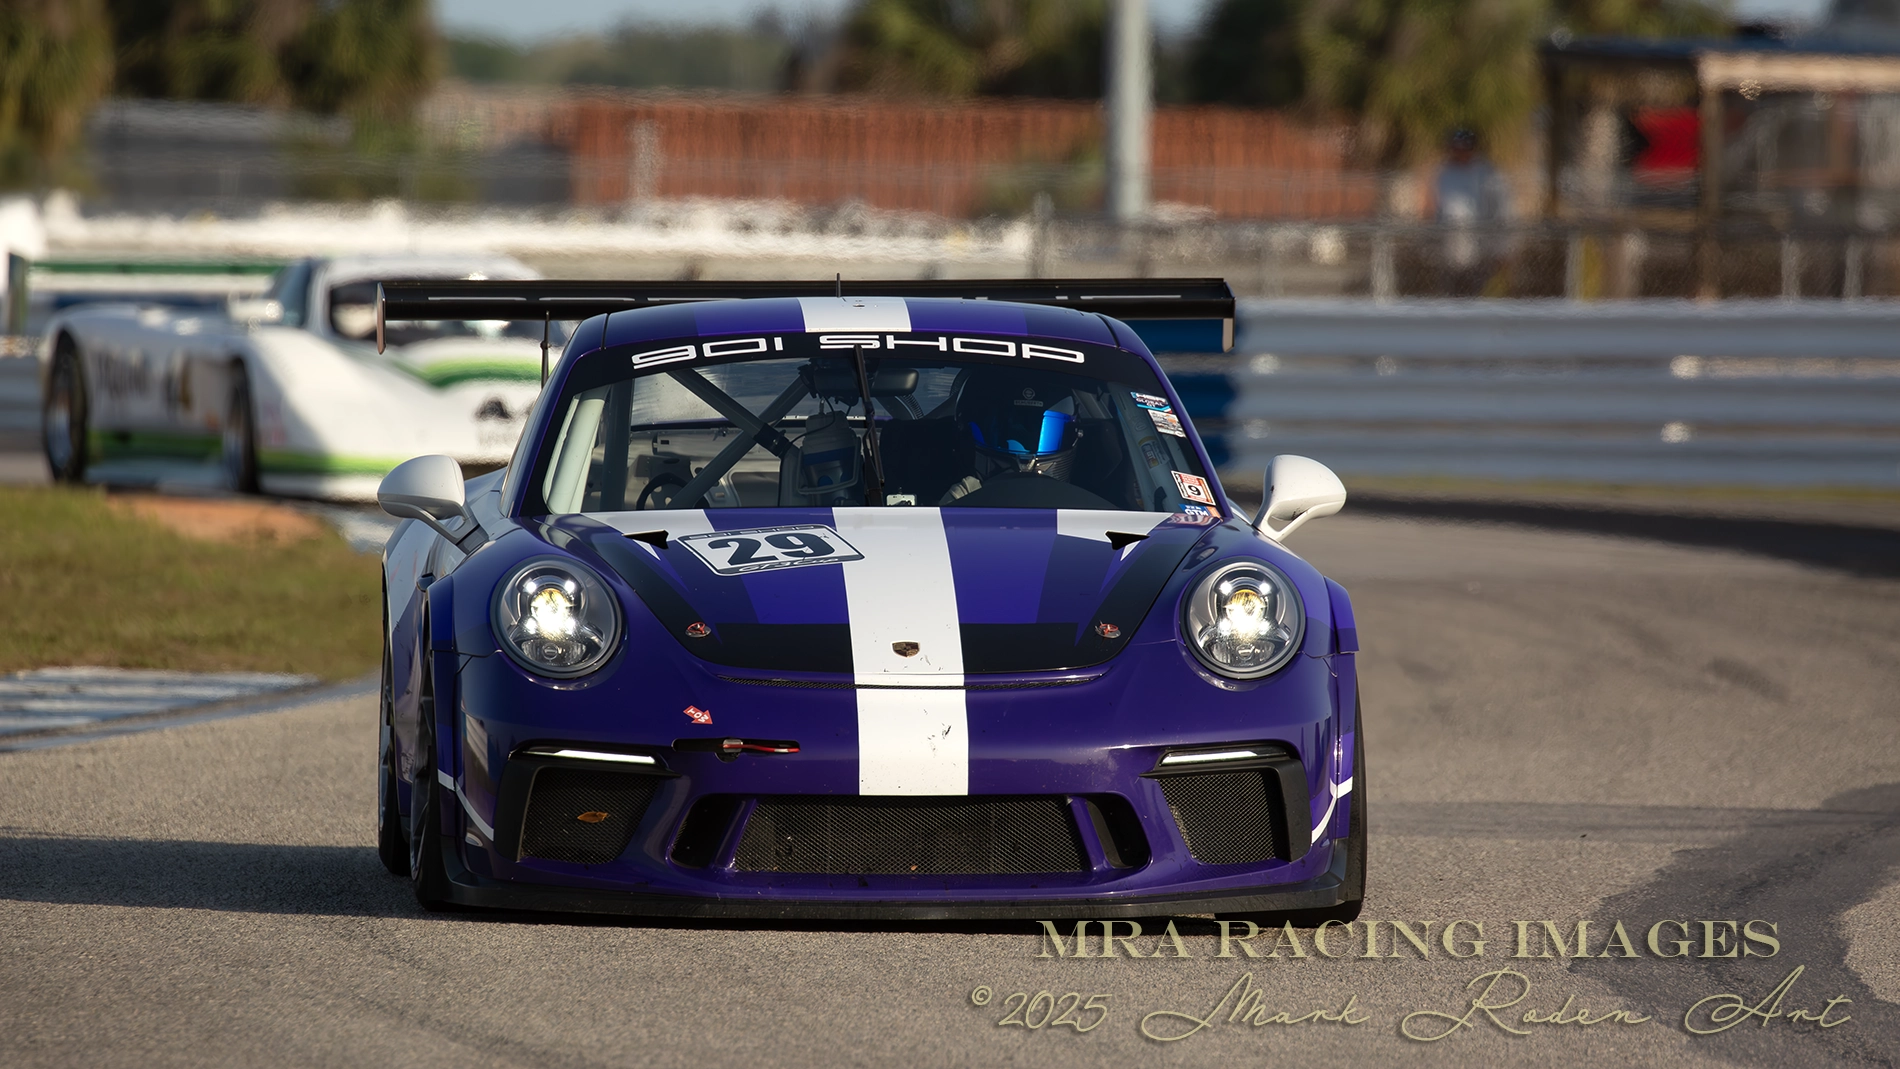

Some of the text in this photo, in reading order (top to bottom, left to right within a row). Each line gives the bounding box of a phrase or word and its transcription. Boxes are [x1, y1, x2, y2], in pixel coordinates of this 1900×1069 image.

[819, 334, 1085, 364] SHOP
[1188, 485, 1201, 496] 9
[708, 533, 835, 566] 29
[687, 708, 709, 723] TOW
